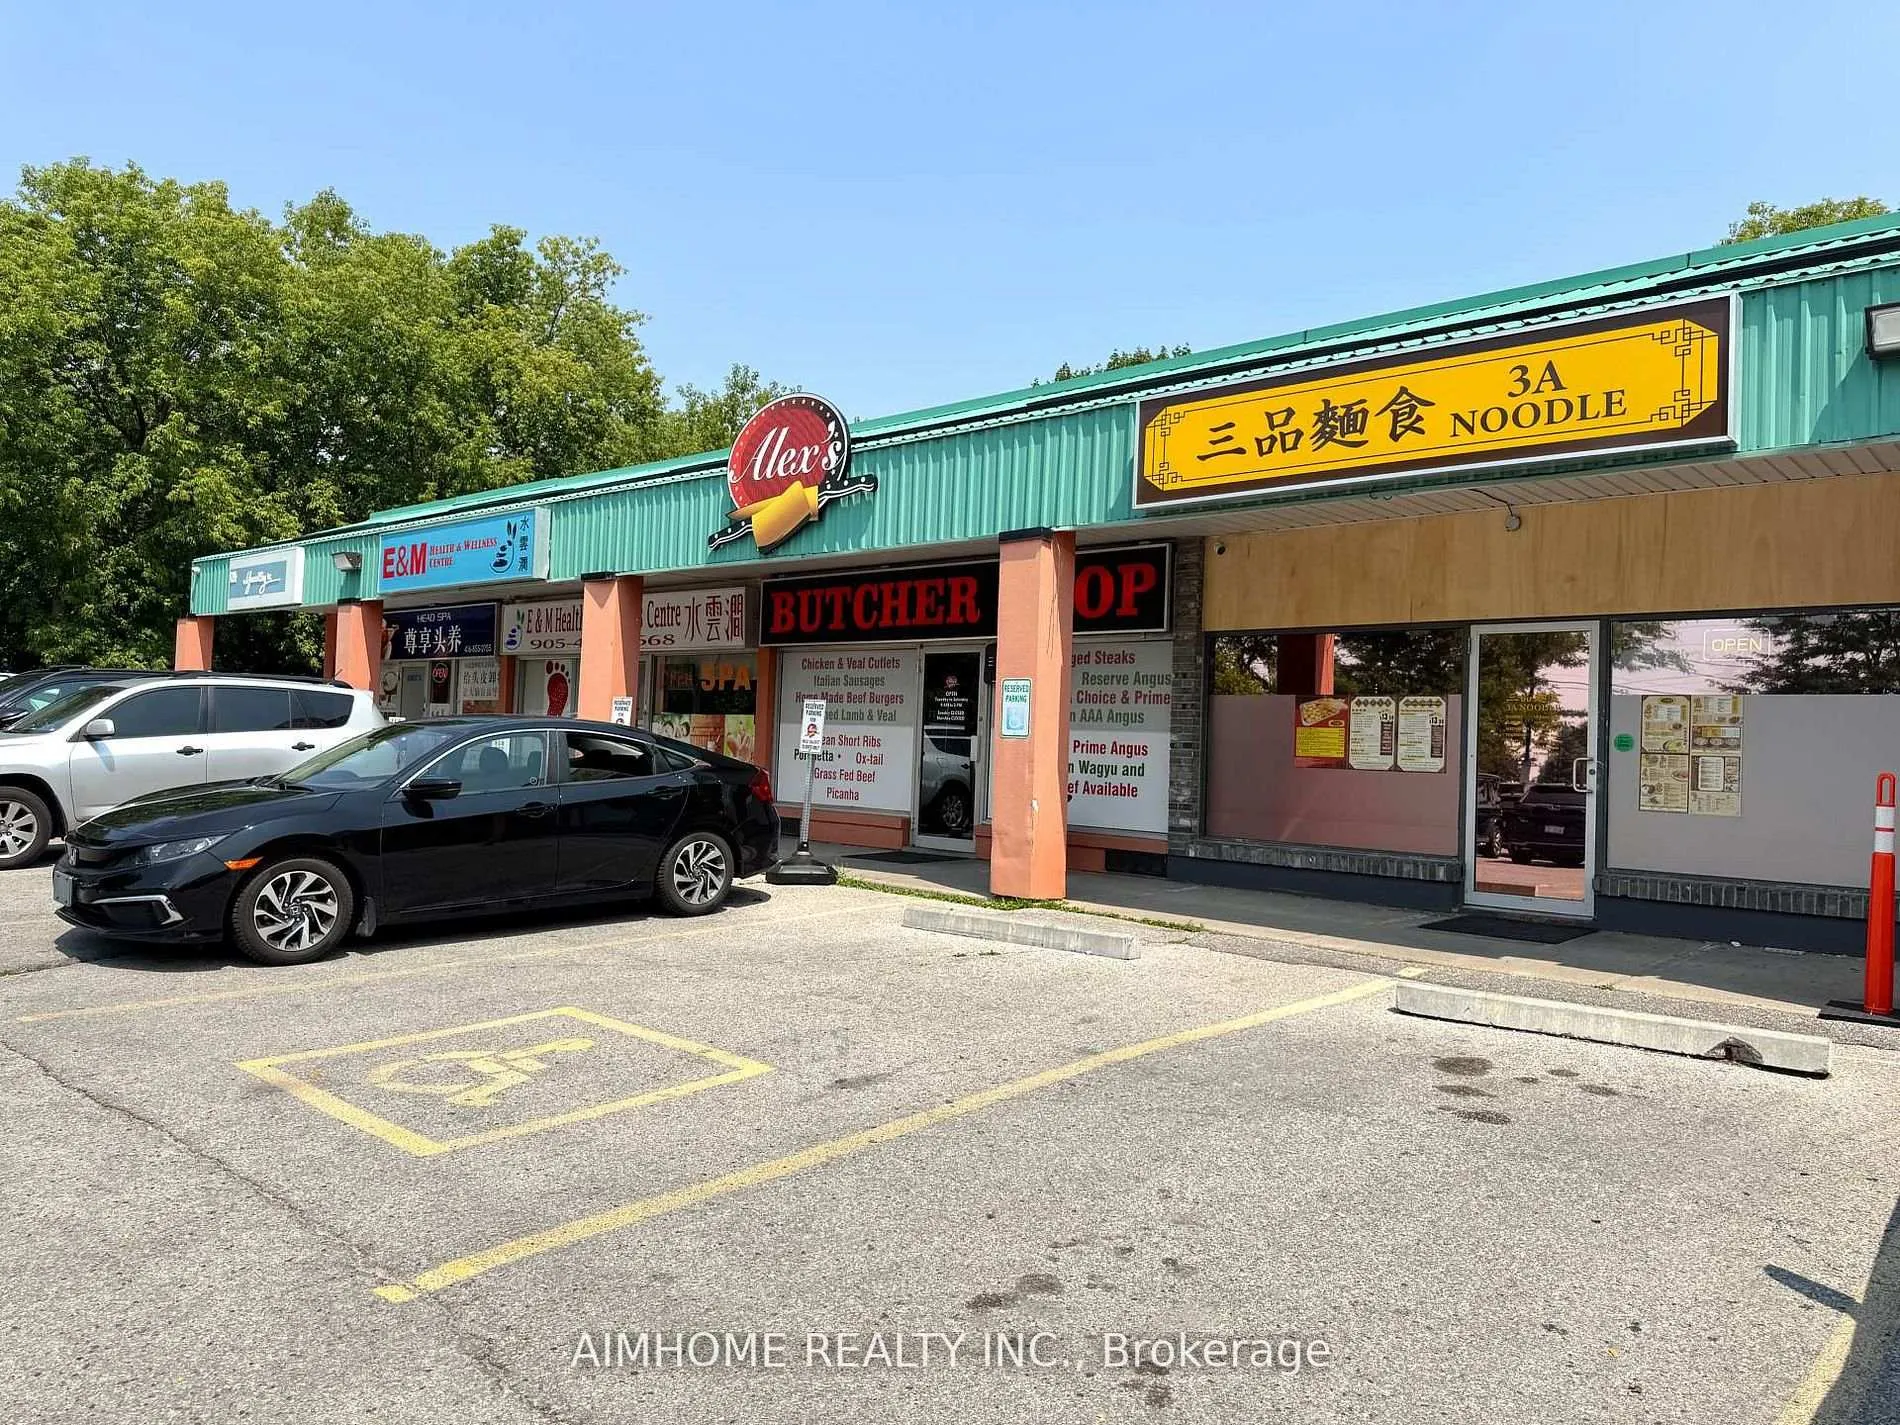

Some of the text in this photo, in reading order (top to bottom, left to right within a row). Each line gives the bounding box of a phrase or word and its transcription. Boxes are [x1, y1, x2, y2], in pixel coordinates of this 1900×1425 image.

[1508, 360, 1568, 398] 3A
[1450, 389, 1627, 437] NOODLE
[1196, 385, 1435, 459] 三品麵食
[729, 420, 846, 484] Alex's
[429, 544, 455, 556] HEALTH
[463, 537, 498, 551] WELLNESS
[382, 541, 427, 579] E&M
[769, 563, 1158, 634] BUTCHER OP
[437, 611, 452, 622] SPA
[526, 608, 533, 633] E
[535, 608, 543, 633] &
[545, 608, 553, 633] M
[646, 600, 681, 629] Centre
[403, 624, 462, 656] 尊享头养
[1711, 638, 1761, 652] OPEN
[801, 656, 901, 670] Chicken & Veal Cutlets
[1071, 650, 1136, 668] ged Steaks
[701, 662, 751, 691] SPA
[814, 675, 886, 688] Italian Sausages
[1081, 671, 1172, 688] Reserve Angus
[1004, 684, 1029, 693] RESERVED
[821, 691, 844, 703] Made
[847, 691, 867, 703] Beef
[870, 691, 905, 706] Burgers
[1005, 694, 1027, 703] PARKING
[1076, 690, 1116, 705] Choice
[1121, 690, 1130, 705] &
[1134, 690, 1170, 705] Prime
[841, 709, 864, 721] Lamb
[867, 710, 874, 721] &
[876, 709, 897, 721] Veal
[1080, 709, 1103, 723] AAA
[1106, 709, 1144, 726] Angus
[838, 734, 861, 747] Short
[863, 735, 882, 748] Ribs
[1073, 739, 1149, 758] Prime Angus
[855, 752, 884, 766] Ox-tail
[814, 767, 875, 783] Grass Fed Beef
[1079, 760, 1118, 778] Wagyu
[1122, 762, 1145, 777] and
[826, 786, 860, 801] Picanha
[1067, 780, 1138, 798] ef Available
